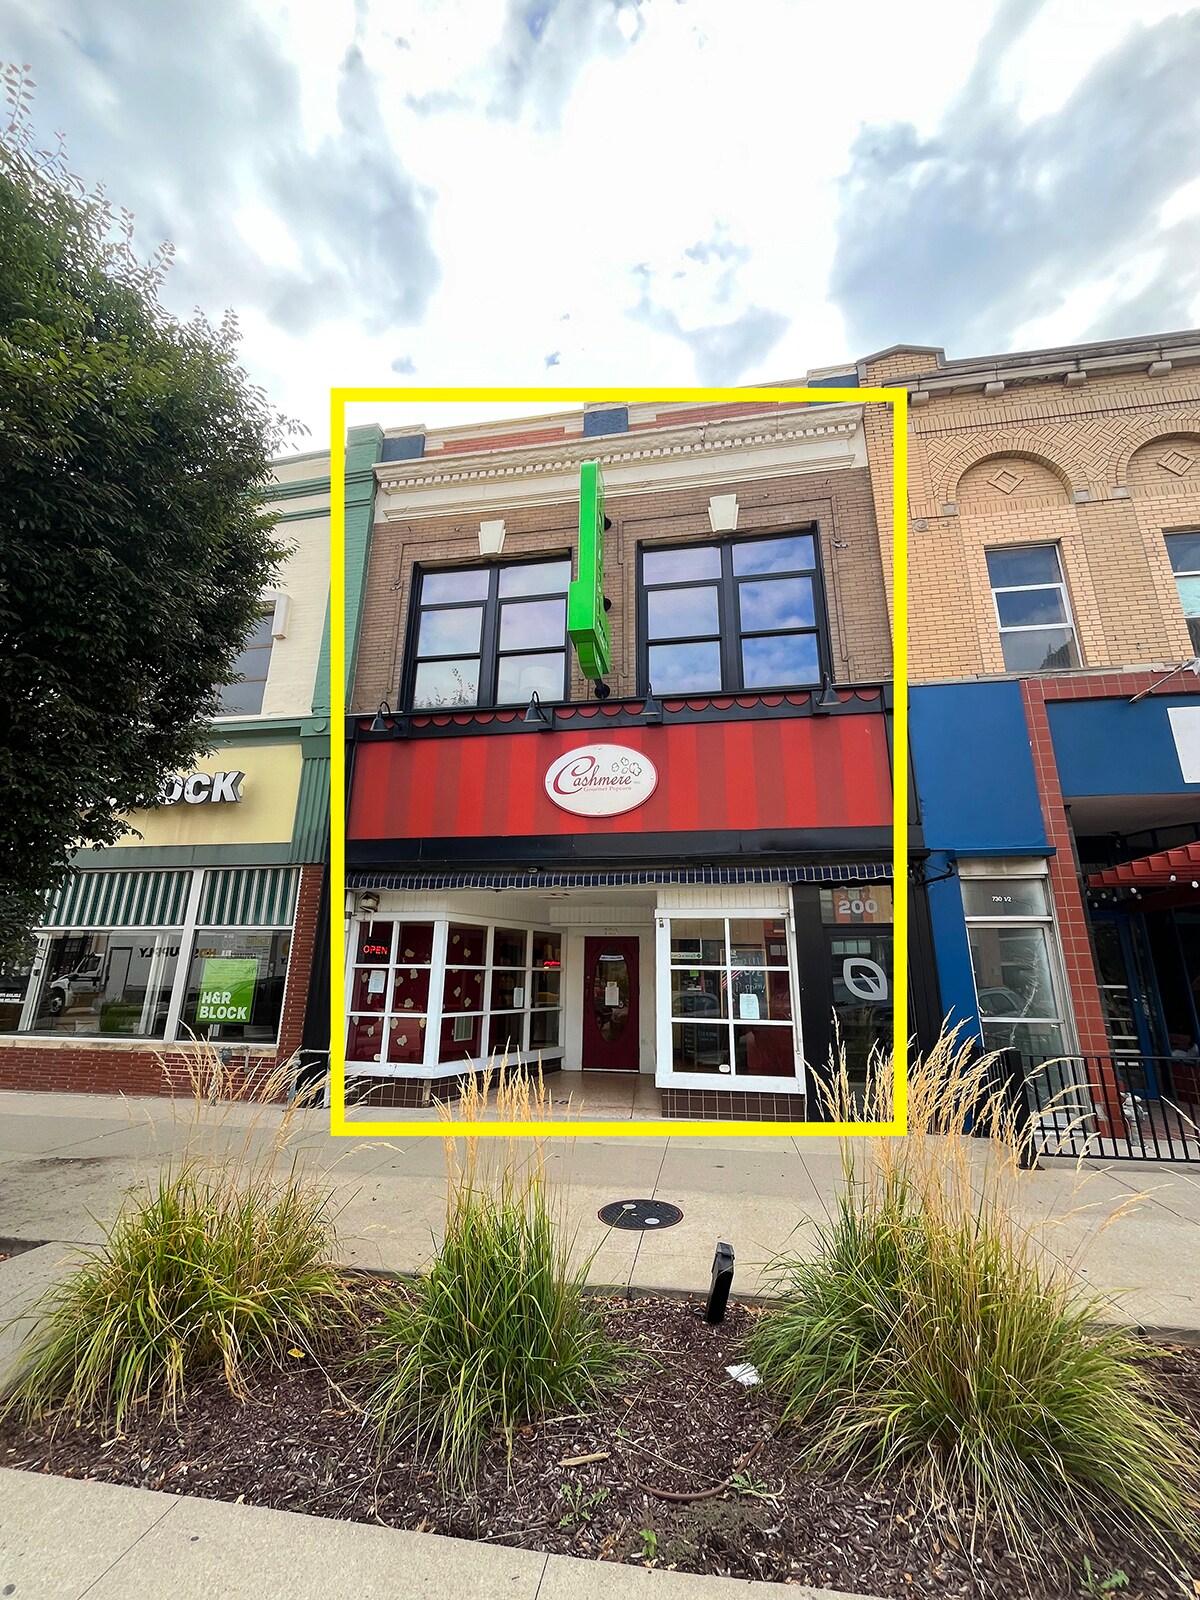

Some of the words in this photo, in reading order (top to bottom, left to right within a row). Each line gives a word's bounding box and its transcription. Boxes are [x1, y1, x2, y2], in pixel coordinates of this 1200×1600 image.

[553, 755, 632, 795] Cashmere
[154, 771, 242, 805] OCK
[838, 900, 878, 914] 200
[363, 945, 388, 955] OPEN
[201, 992, 232, 1005] H&R
[199, 1006, 247, 1020] BLOCK
